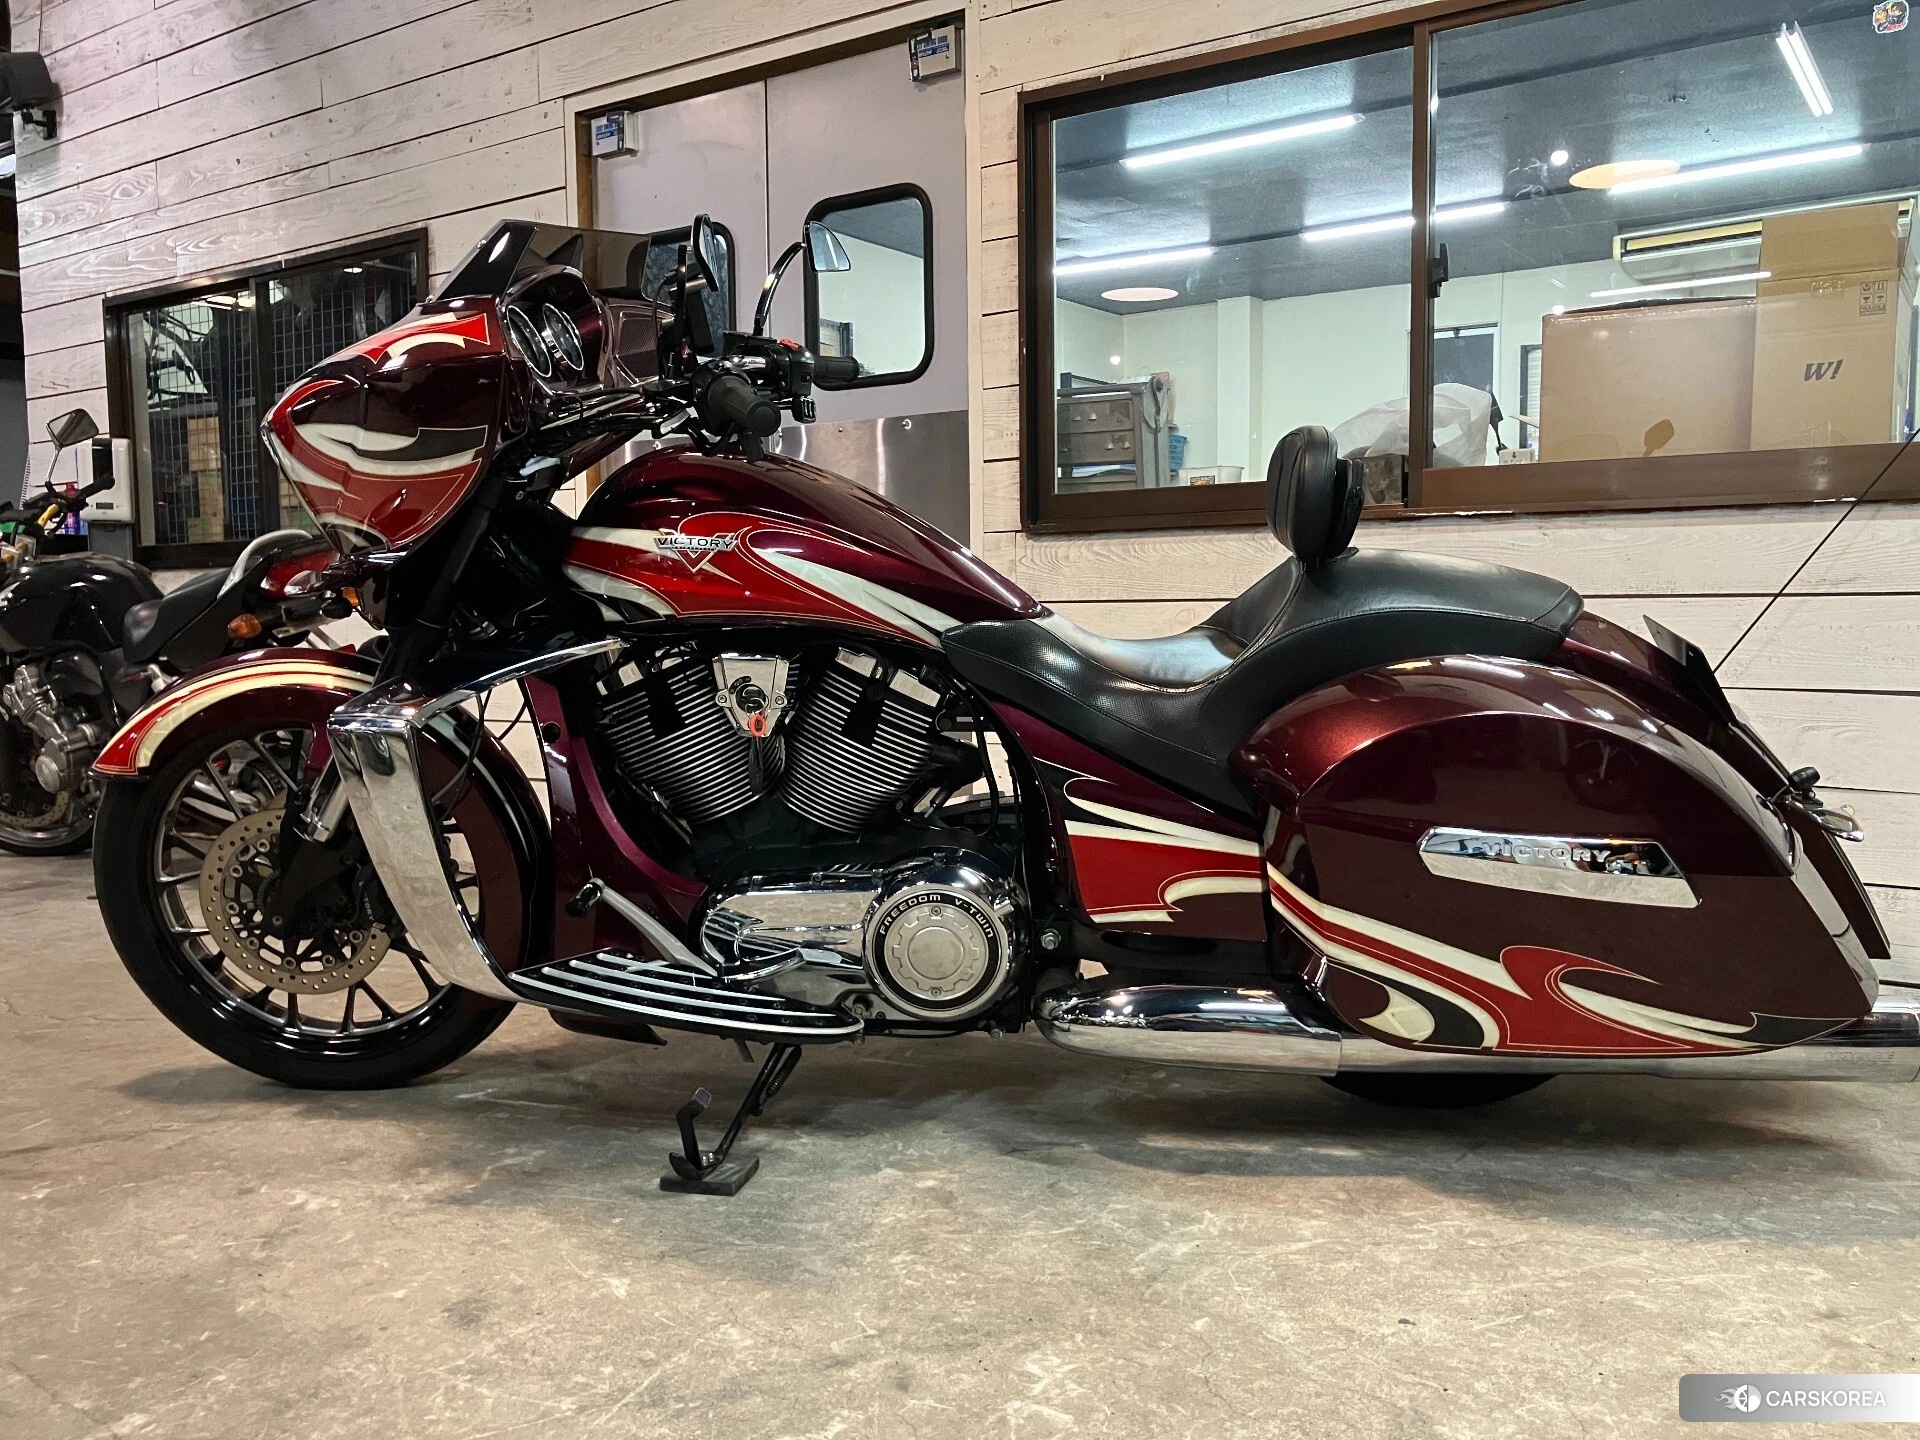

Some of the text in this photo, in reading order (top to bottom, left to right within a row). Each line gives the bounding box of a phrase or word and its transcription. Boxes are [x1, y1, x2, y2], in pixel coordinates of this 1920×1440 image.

[657, 537, 733, 550] VICTORY
[1480, 838, 1611, 862] VICTORY
[880, 894, 994, 938] FREEDOM V-TWIN
